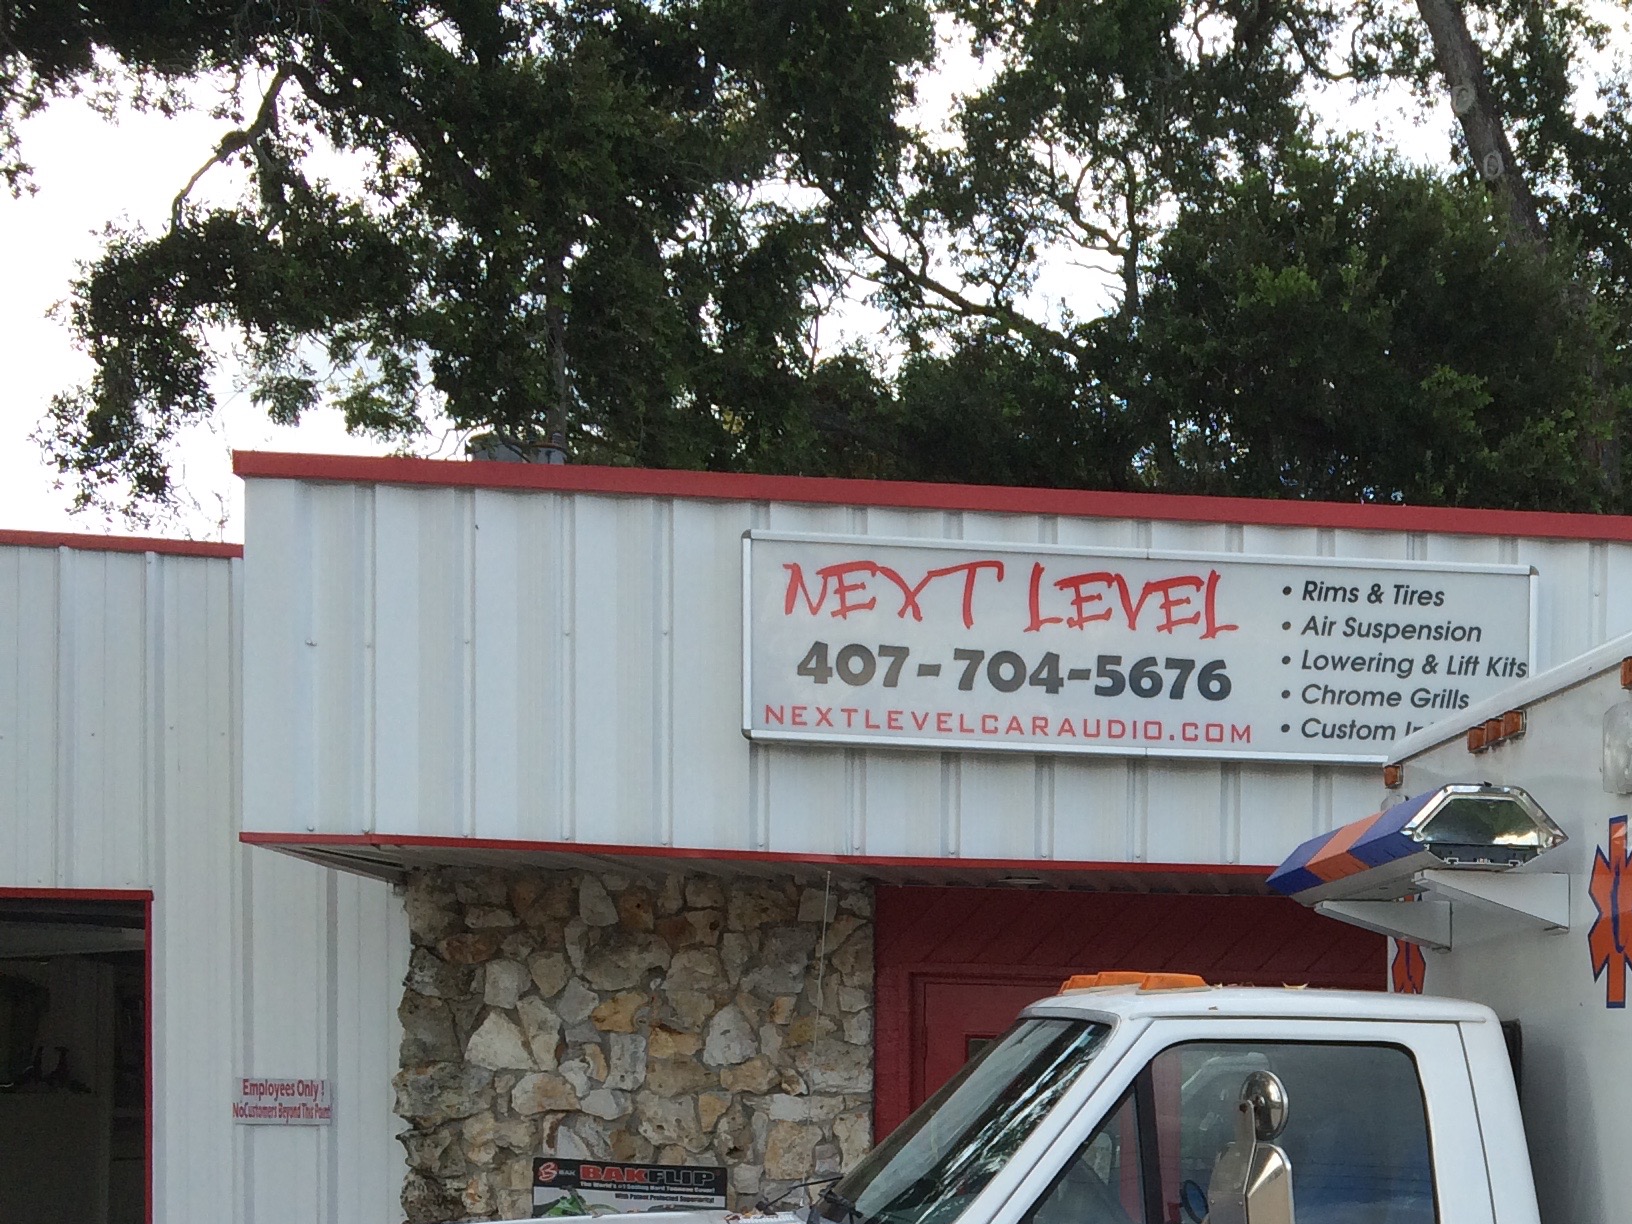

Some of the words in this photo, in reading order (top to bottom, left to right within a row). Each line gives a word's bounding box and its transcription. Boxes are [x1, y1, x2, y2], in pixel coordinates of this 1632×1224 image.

[782, 559, 1004, 630] NEXT
[1023, 561, 1240, 640] LEVEL
[1301, 580, 1360, 604] Rims
[1366, 583, 1385, 605] &
[1393, 584, 1446, 607] Tires
[1300, 615, 1337, 638] Air
[1342, 616, 1483, 644] Suspension
[796, 640, 1233, 701] 407-704-5676
[1300, 650, 1414, 679] Lowering
[1421, 654, 1439, 675] &
[1446, 655, 1481, 676] Lift
[1486, 656, 1528, 679] Kits
[1300, 684, 1403, 708] Chrome
[1410, 687, 1471, 711] Grills
[764, 704, 1252, 744] NEXTLEVELCARAUDIO.COM
[1300, 717, 1397, 742] Custom
[242, 1079, 295, 1101] Employees
[580, 1164, 715, 1187] BAKFLIP
